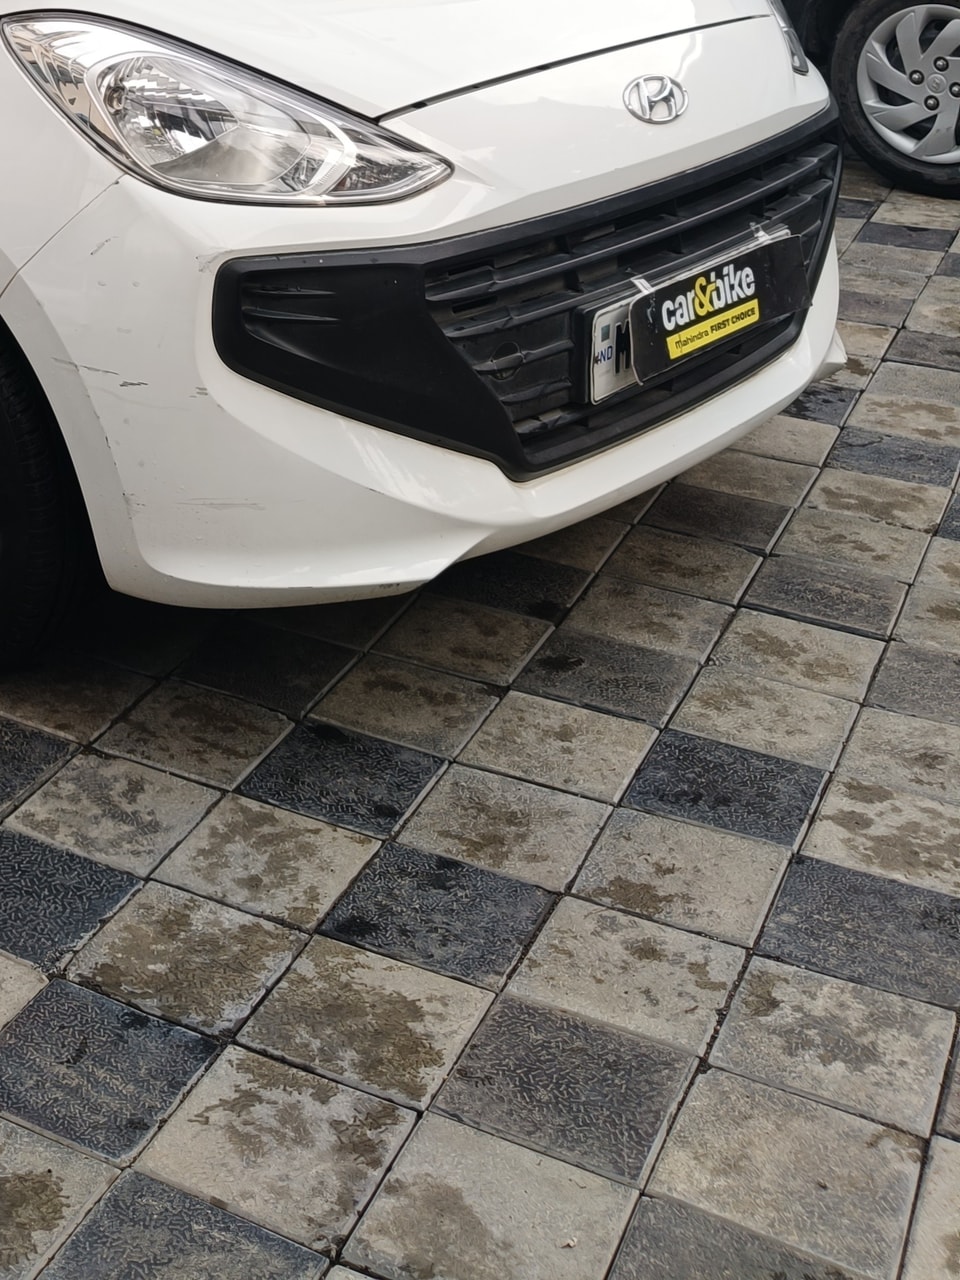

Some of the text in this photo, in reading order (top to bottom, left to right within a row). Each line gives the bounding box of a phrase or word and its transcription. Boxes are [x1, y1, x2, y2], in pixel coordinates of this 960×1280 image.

[661, 263, 756, 331] car&bike
[674, 306, 756, 352] Mahindra FIRST CHOICE
